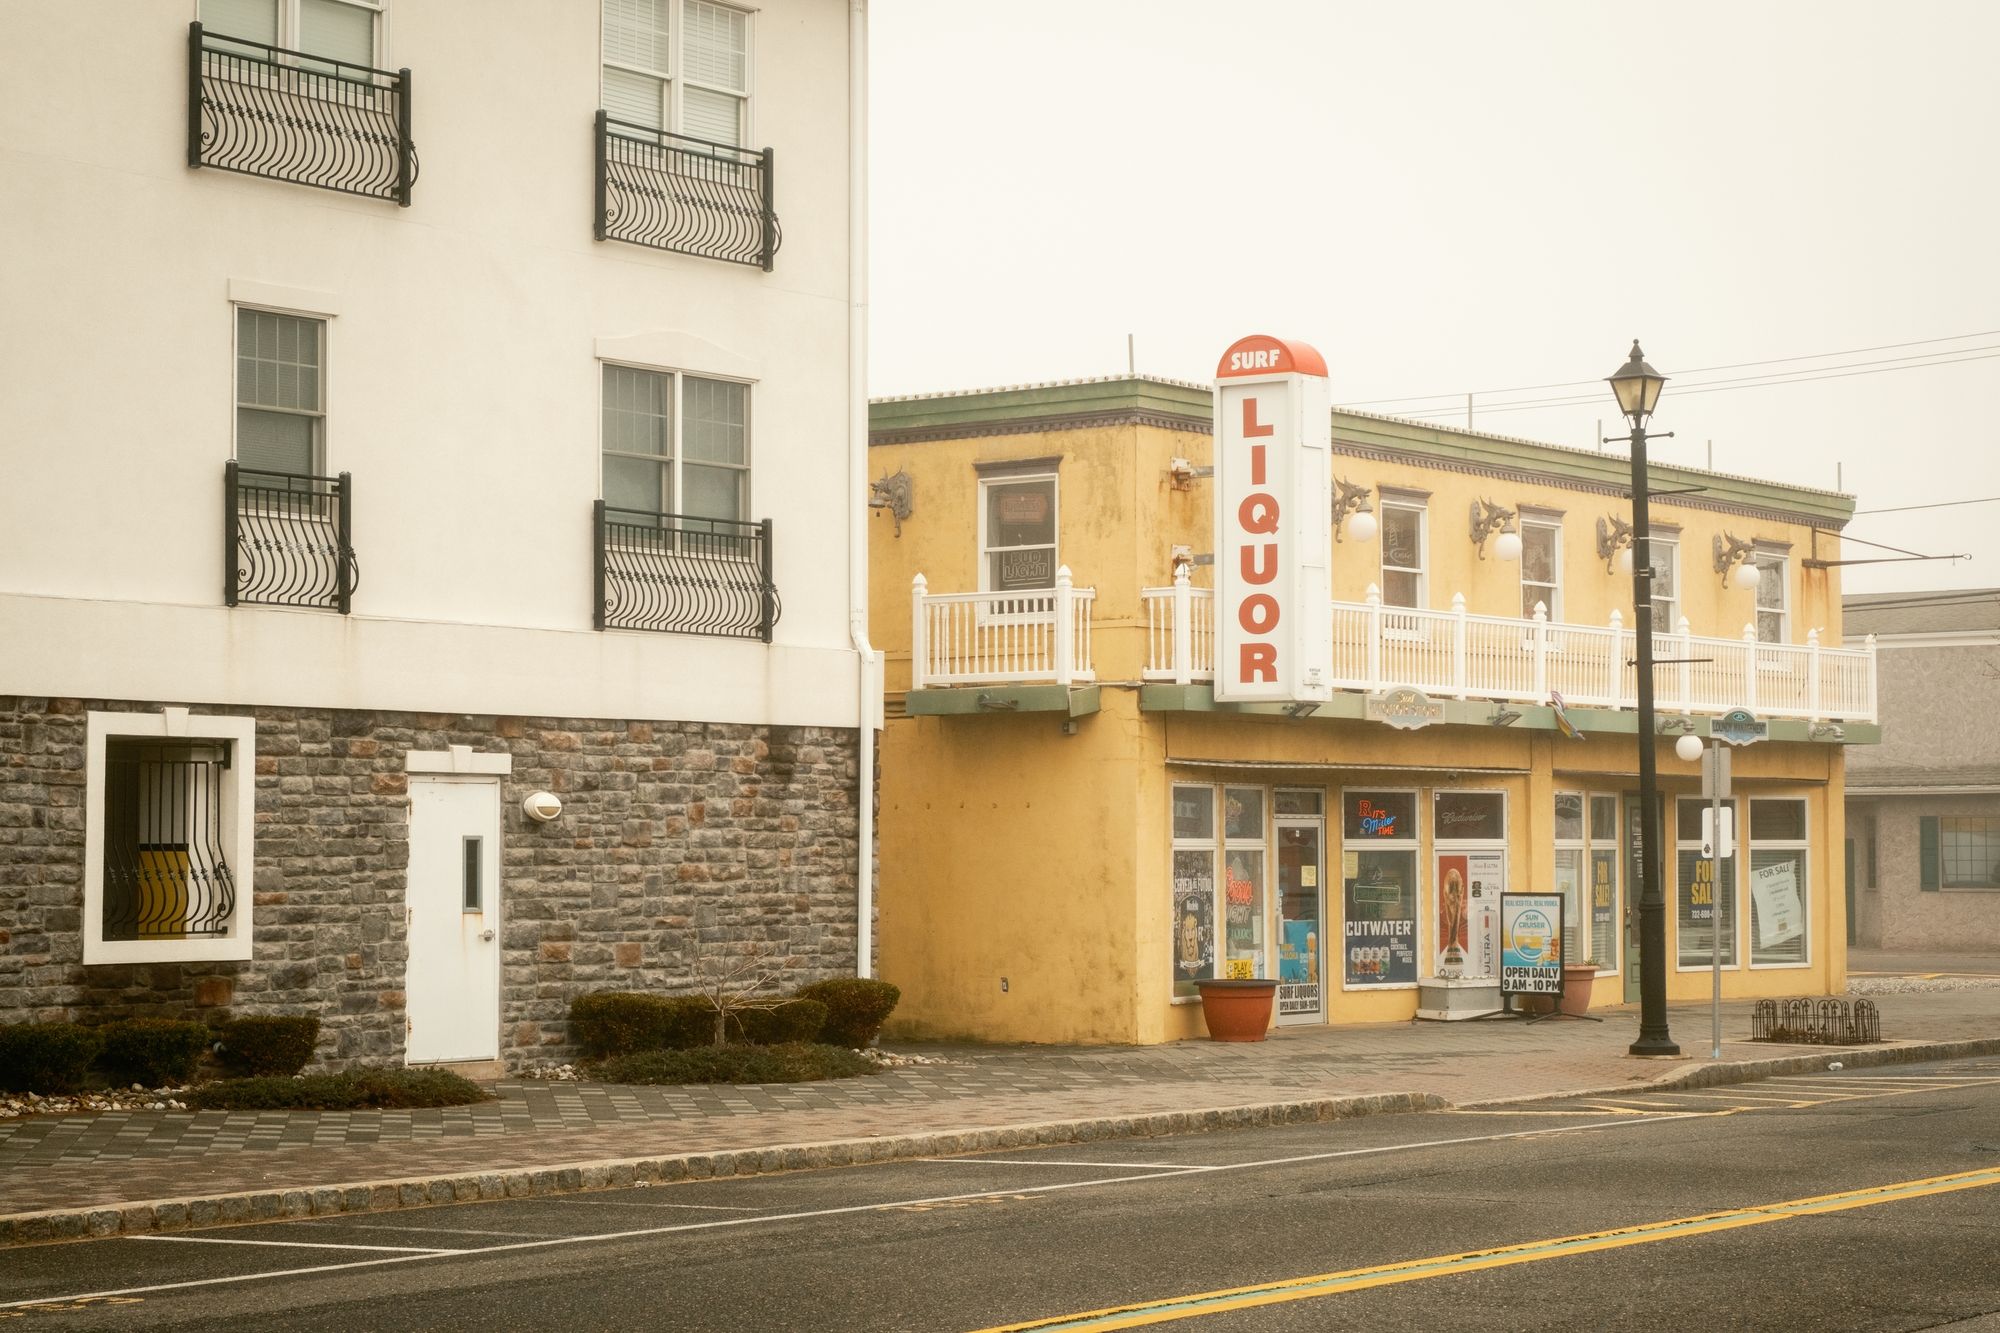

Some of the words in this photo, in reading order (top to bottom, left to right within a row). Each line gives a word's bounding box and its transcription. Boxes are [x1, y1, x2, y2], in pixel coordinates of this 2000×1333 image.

[1231, 349, 1280, 370] SURF
[1238, 398, 1281, 684] LIQUOR
[1004, 562, 1048, 579] LIGHT
[1372, 809, 1387, 819] IT'S
[1441, 811, 1488, 825] Budweiser
[1363, 816, 1397, 834] Miller
[1378, 825, 1395, 836] TIME
[1696, 860, 1714, 882] FO
[1759, 867, 1775, 880] FOR
[1346, 920, 1411, 936] CUTWATER
[1233, 962, 1248, 972] PLAY
[1505, 967, 1530, 978] OPEN
[1532, 967, 1559, 979] DAILY
[1279, 985, 1294, 1000] SURF
[1294, 984, 1318, 1000] LIQUORS
[1504, 980, 1510, 990] 9
[1512, 980, 1527, 990] AM
[1533, 980, 1543, 990] 10
[1545, 980, 1560, 991] PM
[1279, 1001, 1289, 1011] OPEN
